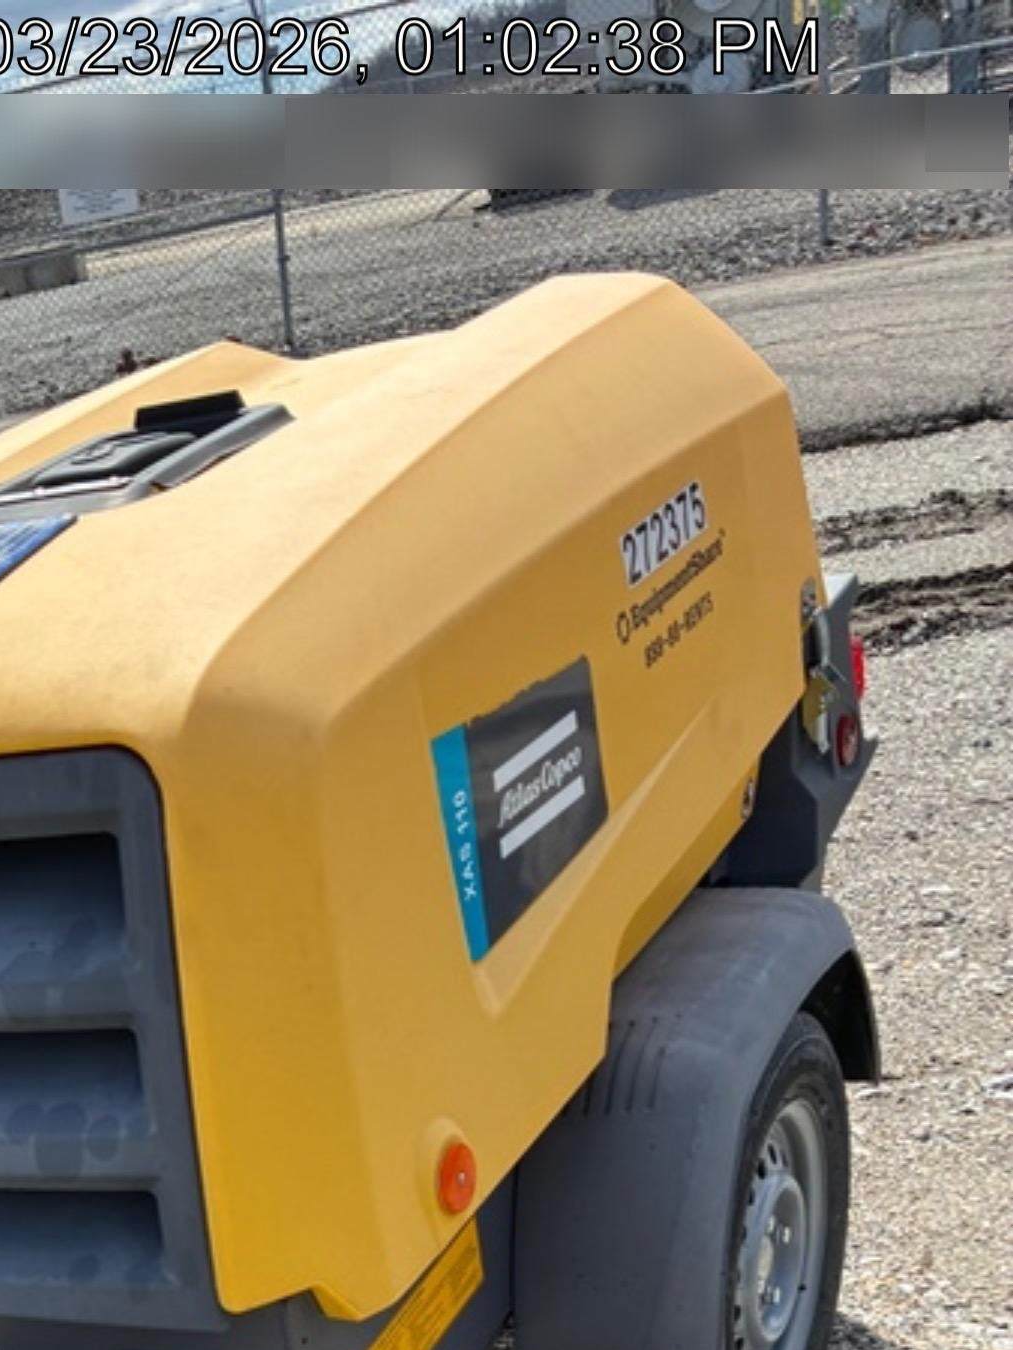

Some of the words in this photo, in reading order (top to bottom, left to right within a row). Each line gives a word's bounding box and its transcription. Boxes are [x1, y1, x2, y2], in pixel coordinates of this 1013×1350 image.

[622, 482, 705, 585] 272375
[451, 789, 471, 834] 110
[459, 843, 477, 901] XAS
